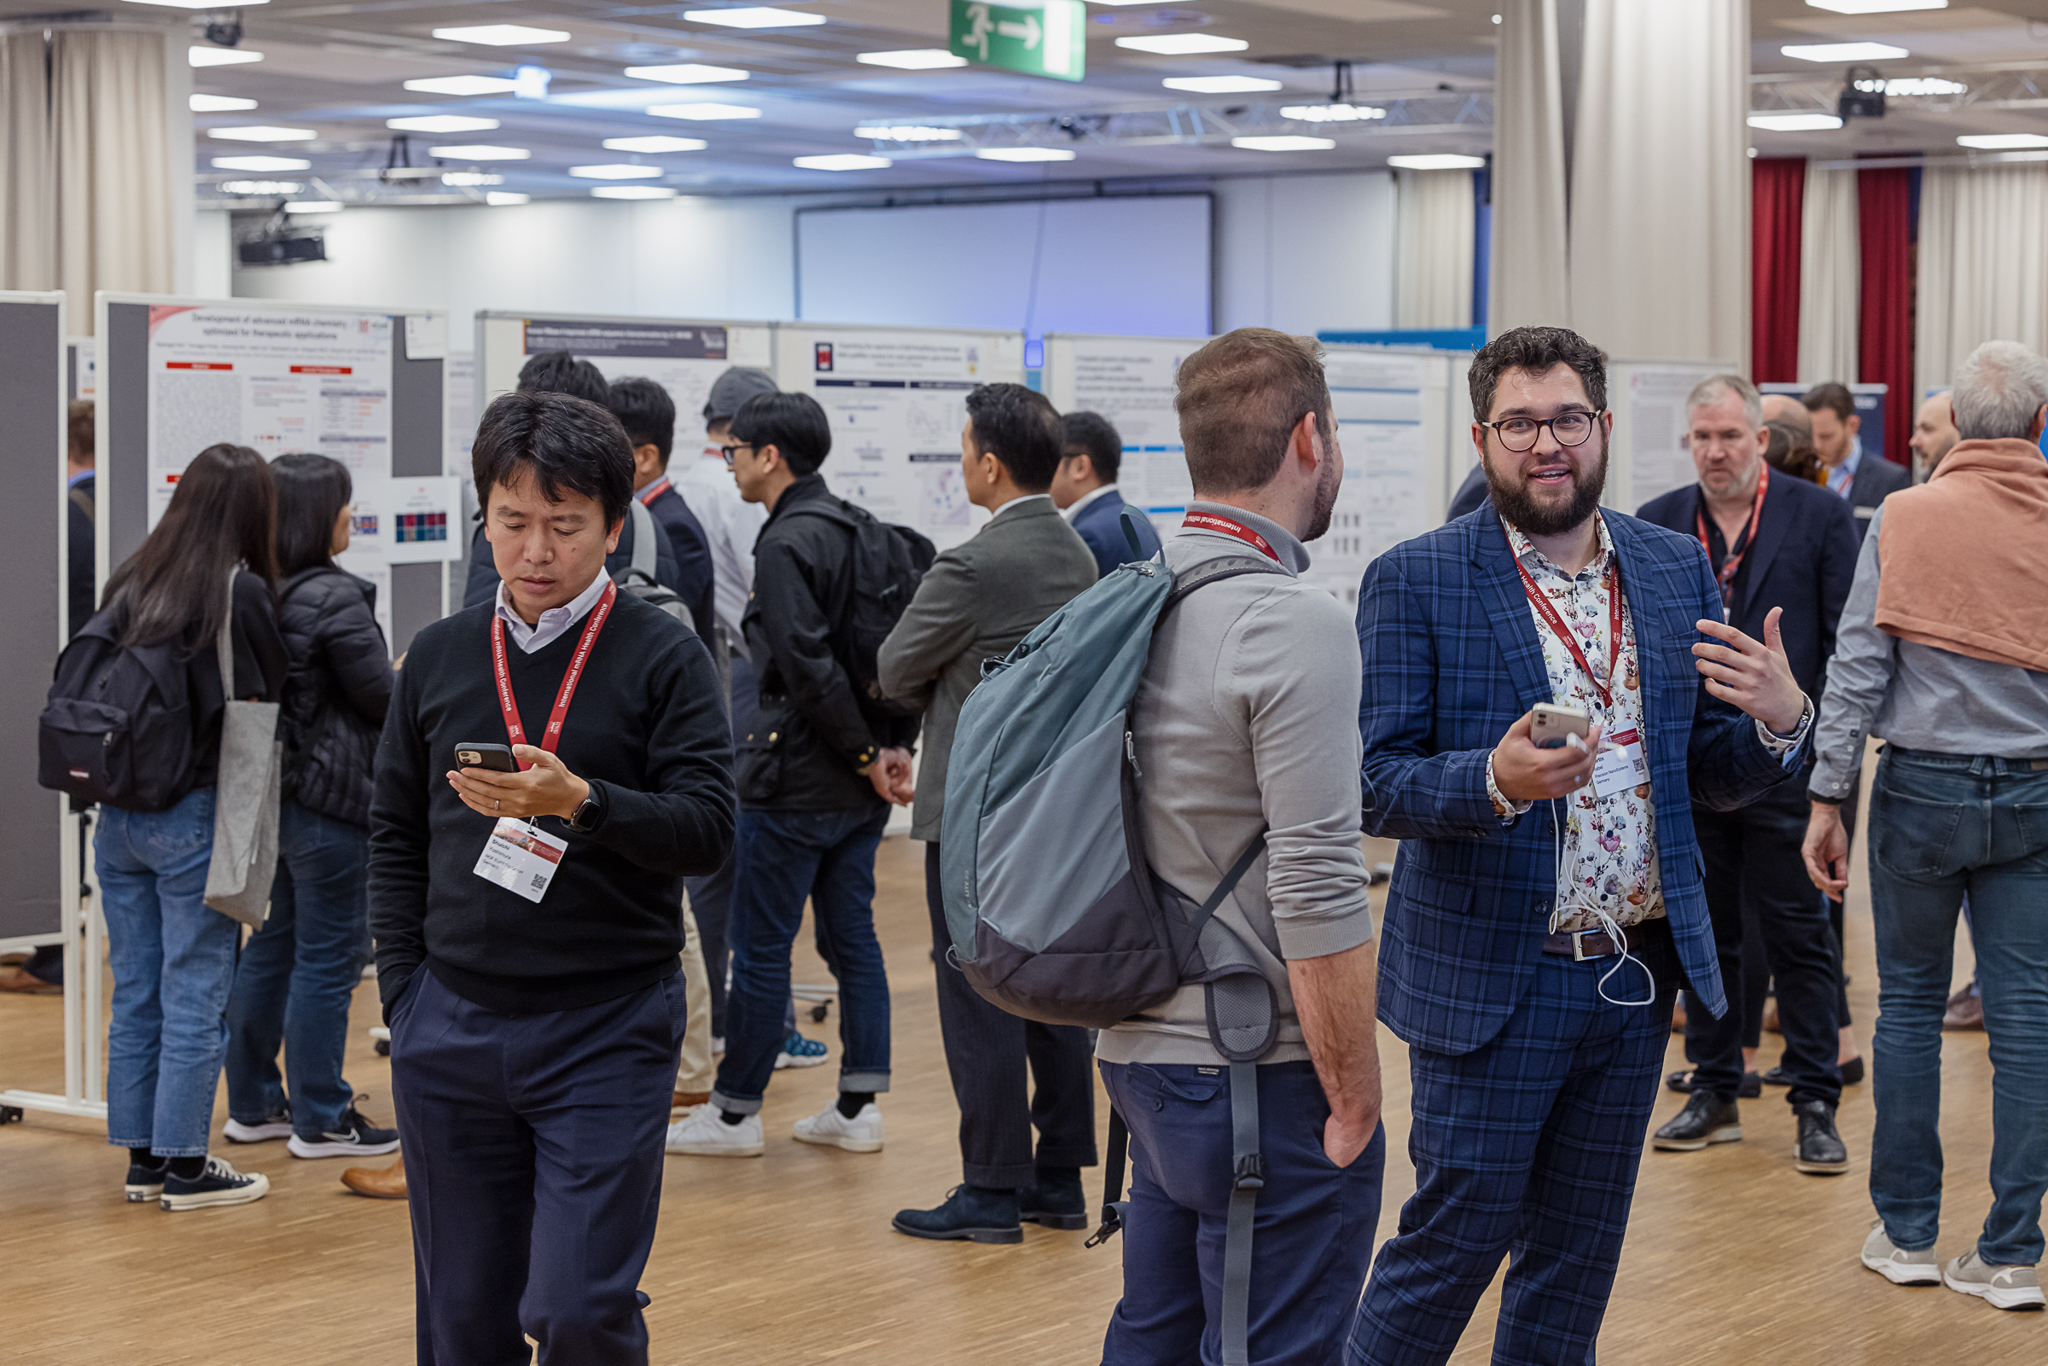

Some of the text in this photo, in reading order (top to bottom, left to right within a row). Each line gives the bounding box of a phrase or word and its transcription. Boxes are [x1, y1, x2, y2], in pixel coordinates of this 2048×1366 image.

[1200, 515, 1241, 533] International
[1520, 574, 1536, 595] Health
[1533, 593, 1558, 625] Conference
[495, 640, 503, 660] mRNA
[558, 603, 608, 708] International mRNA Health Conference
[497, 658, 506, 679] Health
[500, 677, 512, 712] Conference
